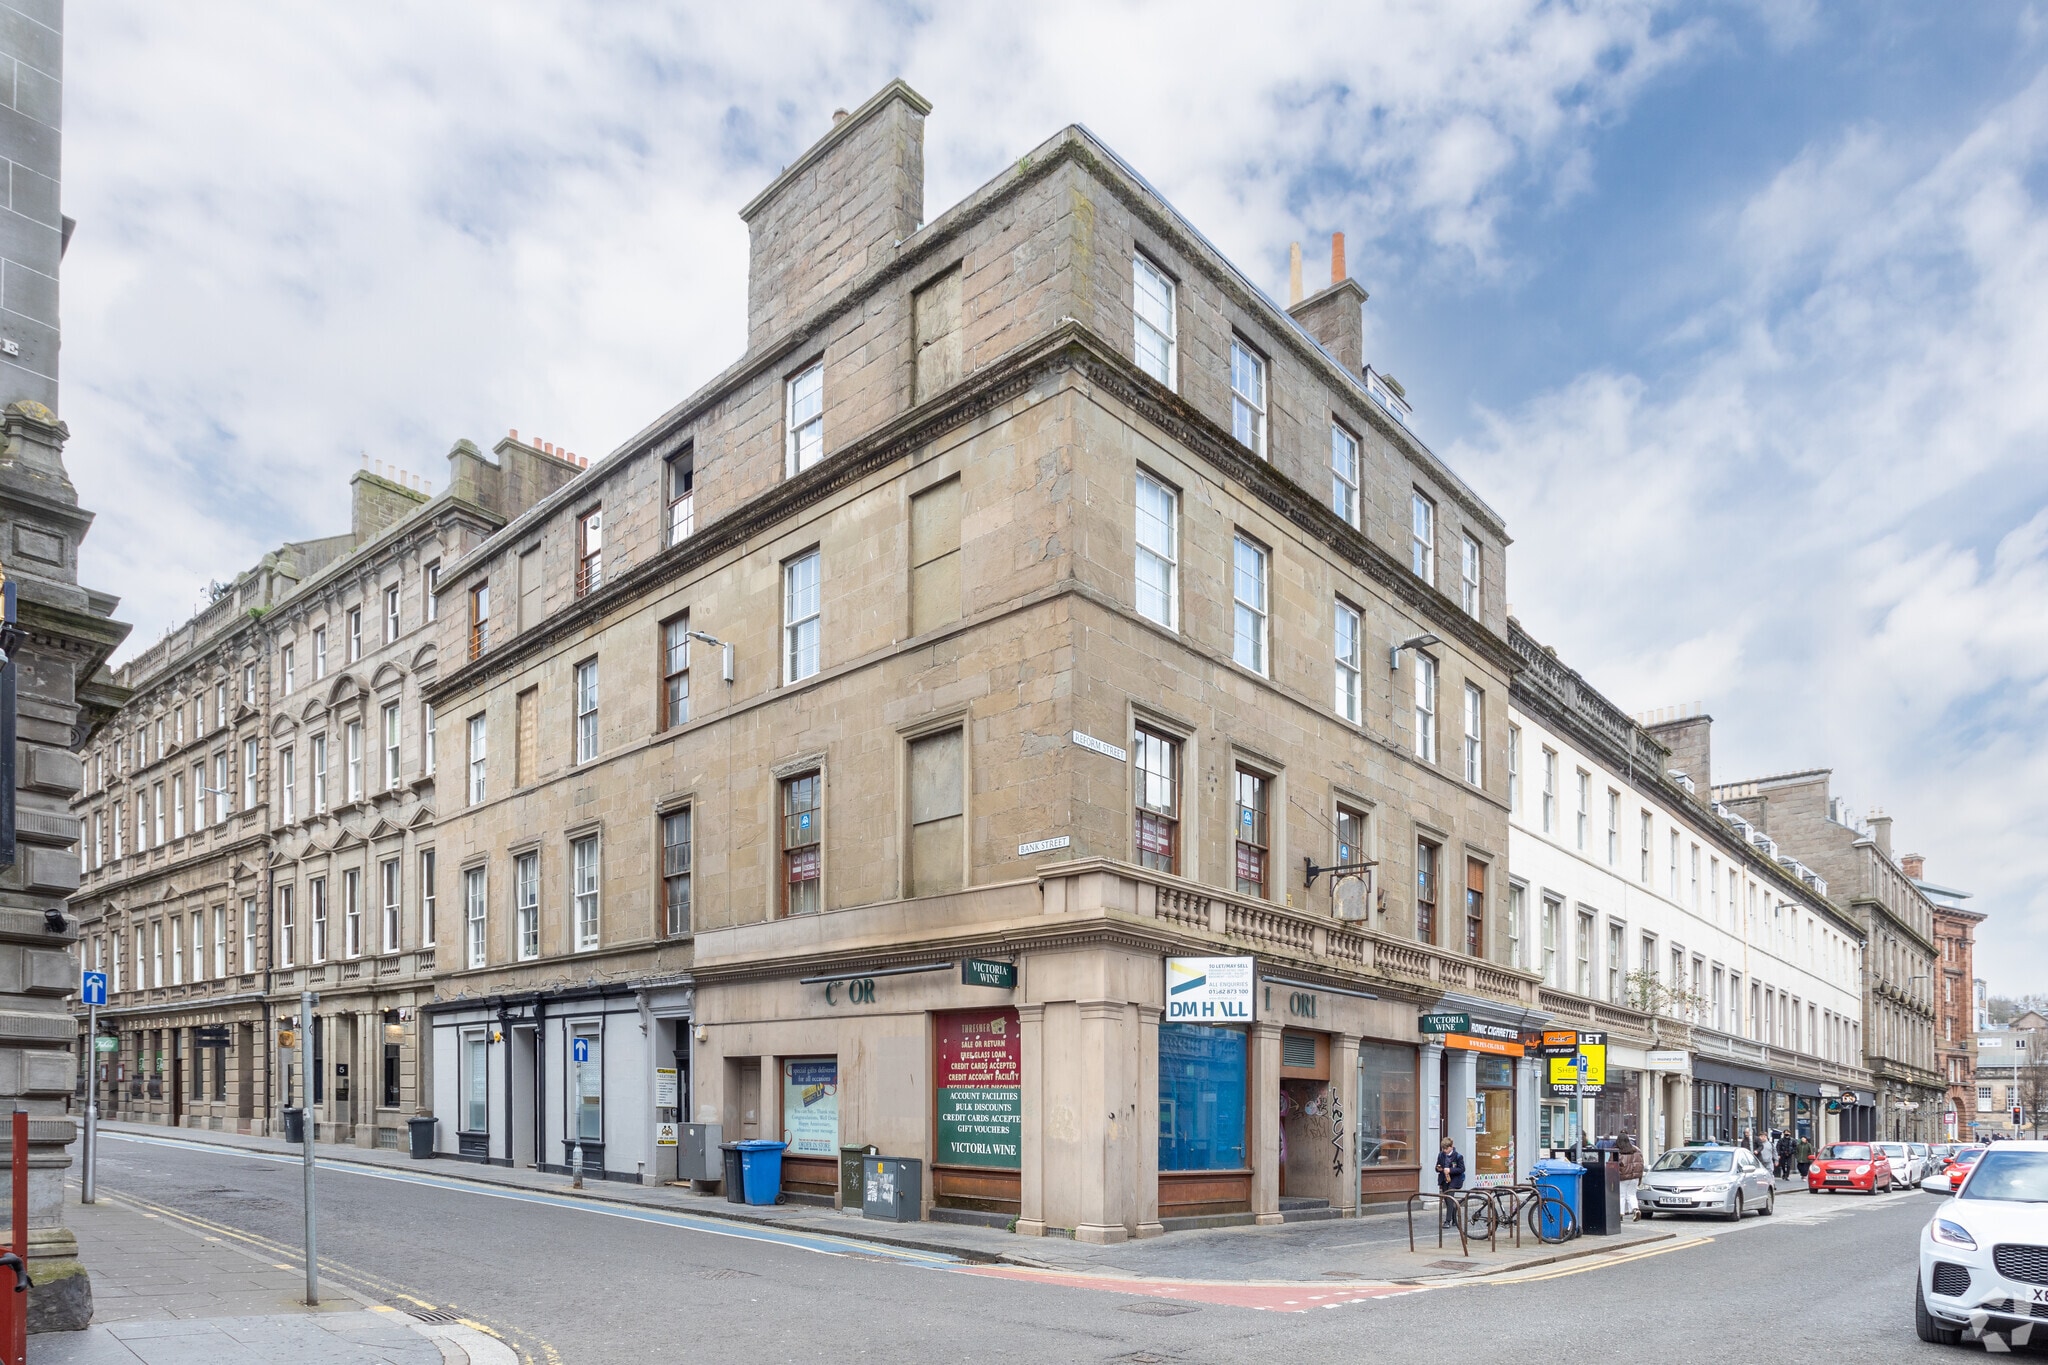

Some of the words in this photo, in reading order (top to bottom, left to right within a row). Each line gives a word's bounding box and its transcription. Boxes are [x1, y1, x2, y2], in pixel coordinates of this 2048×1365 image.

[1076, 733, 1100, 749] REFORM
[1102, 742, 1124, 757] STREET
[1020, 842, 1040, 854] BANK
[1041, 838, 1066, 850] STREET
[972, 962, 1008, 976] VICTORIA
[980, 973, 1000, 984] WINE
[1170, 1002, 1197, 1017] DM
[1202, 1002, 1248, 1017] HALL
[129, 1017, 169, 1029] PEOPLE'S
[175, 1012, 223, 1027] JOURNAL
[962, 1024, 990, 1033] THRESHER
[1471, 1023, 1487, 1034] RONIC
[1488, 1026, 1518, 1039] CIGARETTES
[1579, 1034, 1601, 1044] LET
[1582, 1057, 1586, 1070] P
[974, 1126, 1010, 1134] VOUCHERS
[951, 1142, 991, 1154] VICTORIA
[993, 1144, 1016, 1155] WINE
